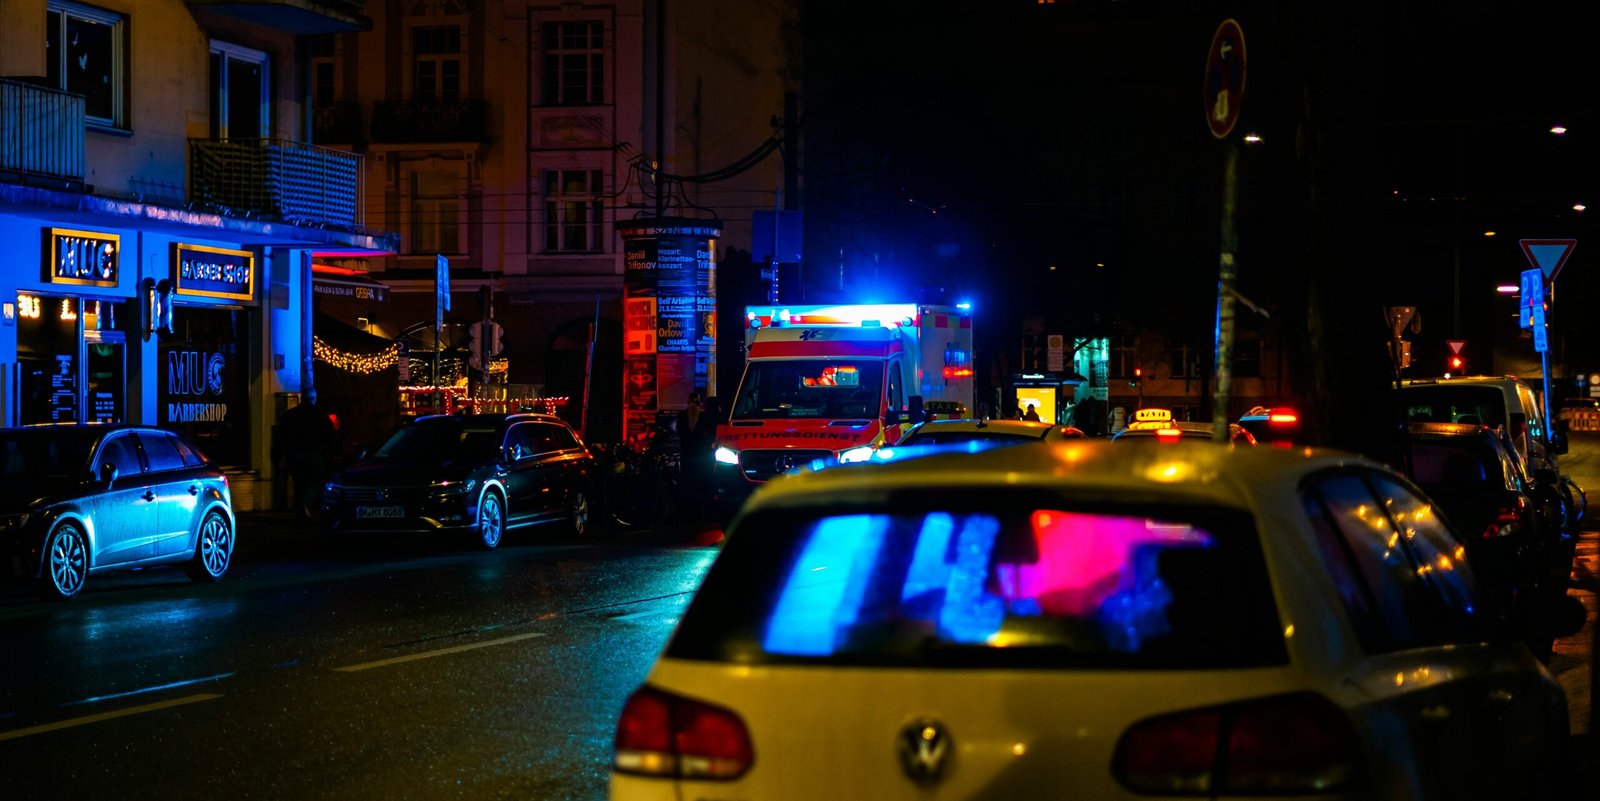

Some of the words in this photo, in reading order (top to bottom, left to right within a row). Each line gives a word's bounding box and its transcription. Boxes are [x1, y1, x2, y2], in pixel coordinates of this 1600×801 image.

[60, 236, 114, 279] MUC
[628, 261, 656, 270] Trifonov
[182, 260, 221, 280] BARBER
[168, 351, 225, 395] MUC
[168, 401, 227, 423] BARBERSHOP
